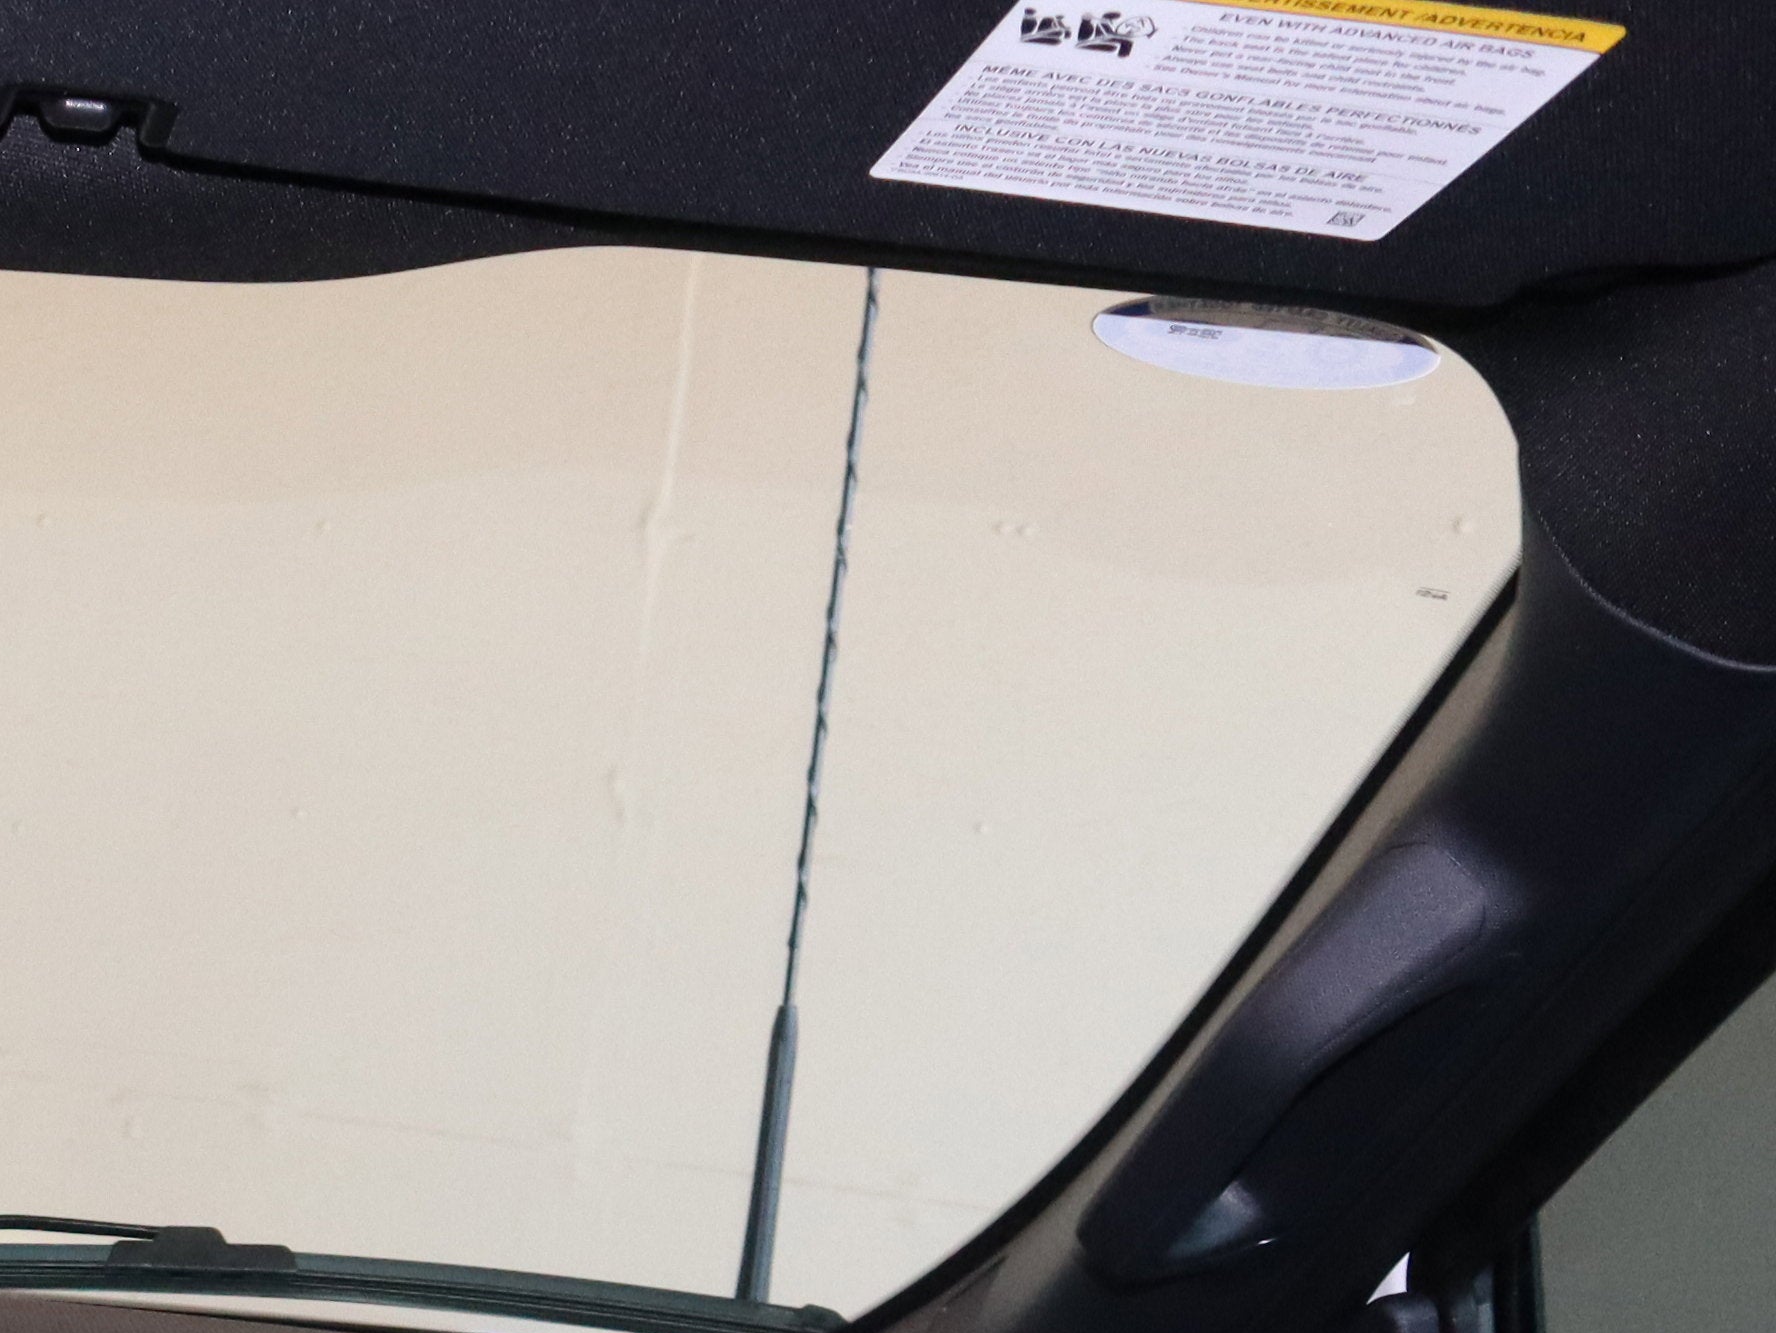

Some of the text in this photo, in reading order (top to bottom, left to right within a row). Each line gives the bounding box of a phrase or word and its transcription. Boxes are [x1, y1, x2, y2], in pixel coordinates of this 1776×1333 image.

[1269, 0, 1414, 22] TISSEMENT
[1217, 12, 1539, 58] EVEN WITH ADVANCED AIR BAGS
[1051, 135, 1097, 148] CON
